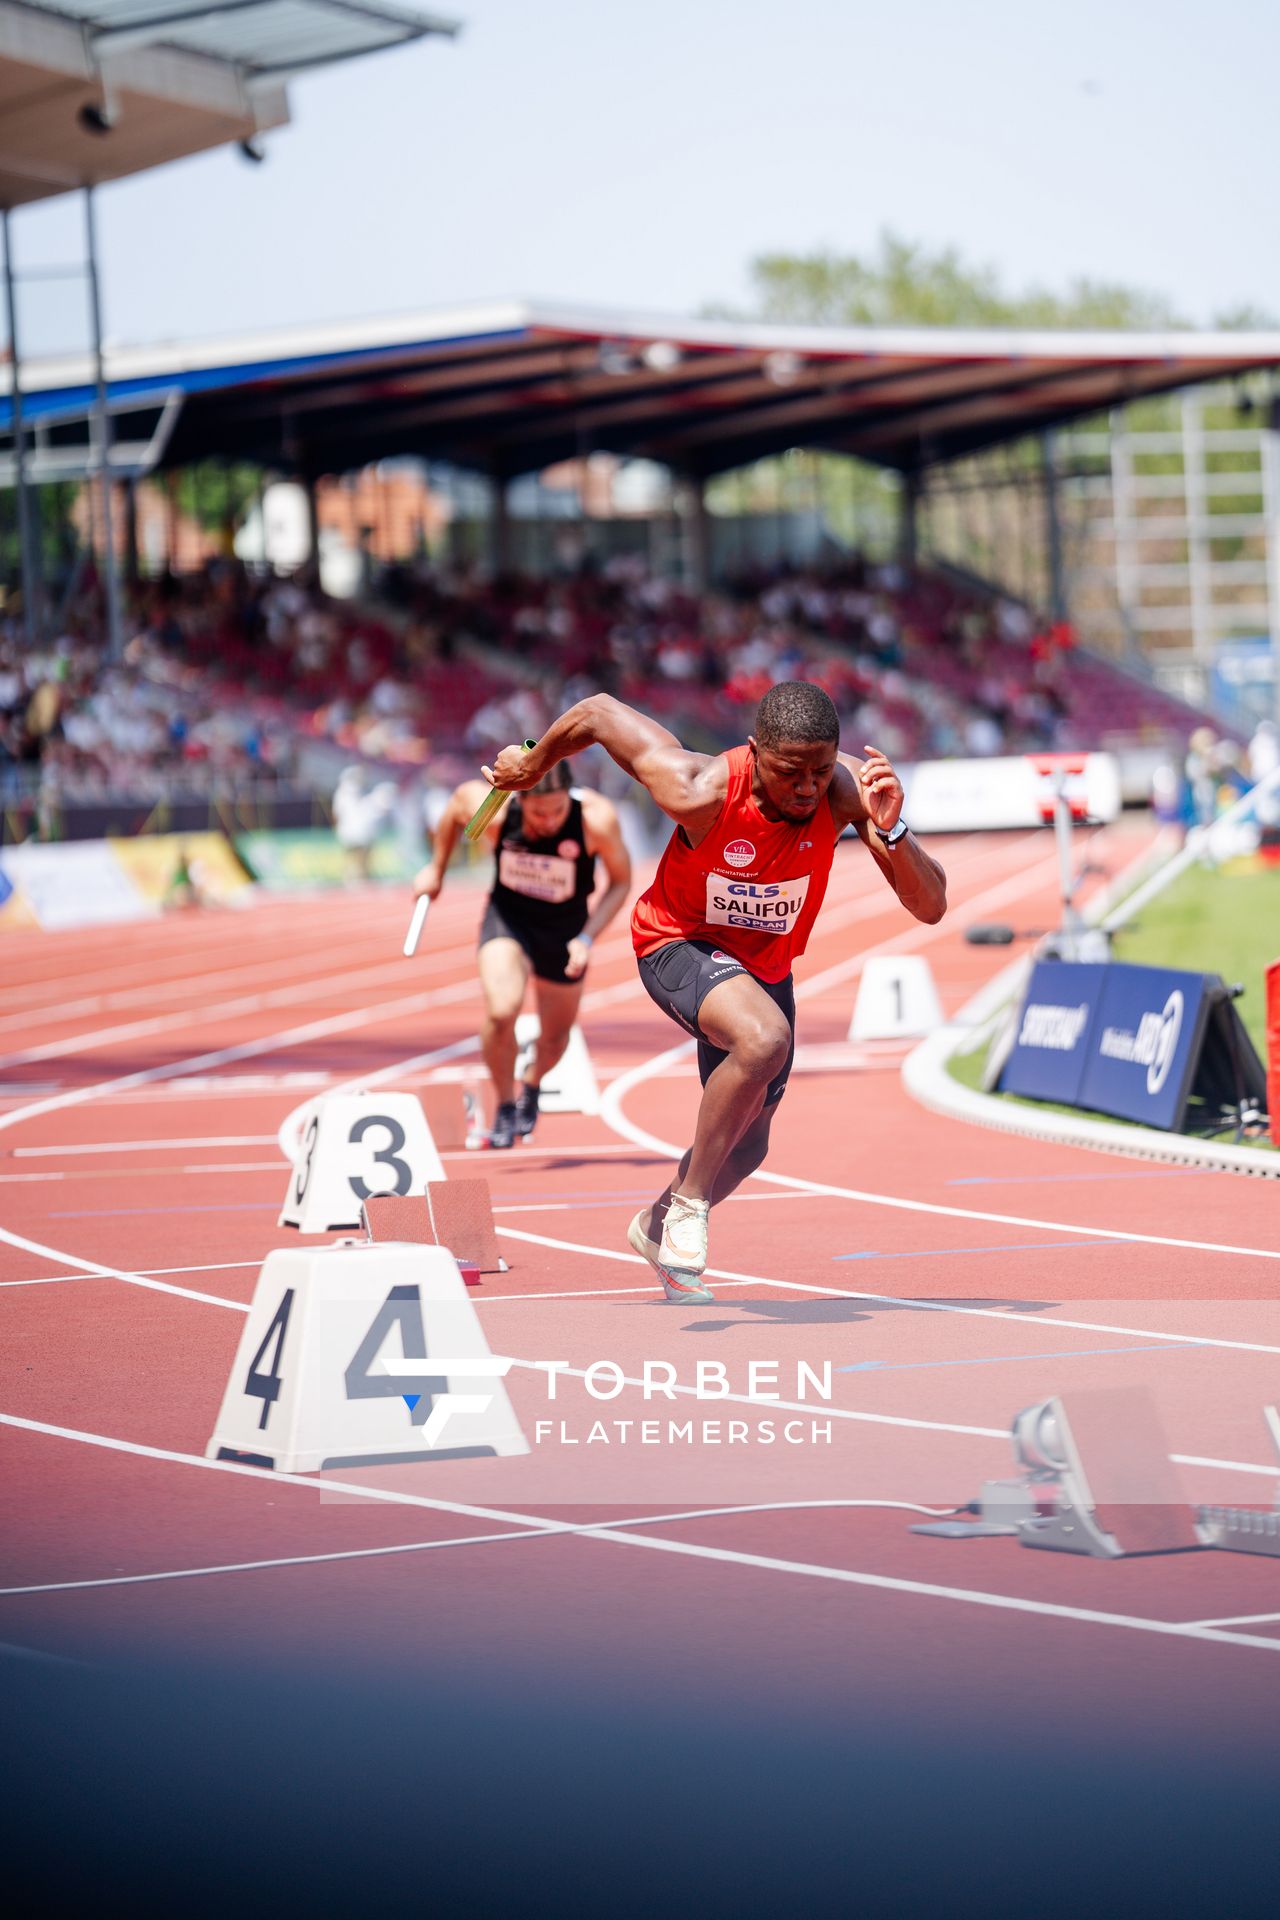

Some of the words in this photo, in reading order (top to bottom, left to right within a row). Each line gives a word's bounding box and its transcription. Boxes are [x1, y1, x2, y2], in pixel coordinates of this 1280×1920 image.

[733, 845, 748, 854] VfL
[713, 896, 802, 917] SALIFOU
[727, 884, 780, 899] GLS
[751, 919, 785, 928] PLAN
[889, 976, 904, 1022] 1
[347, 1115, 413, 1201] 3
[244, 1288, 296, 1430] 4
[344, 1284, 449, 1427] 4
